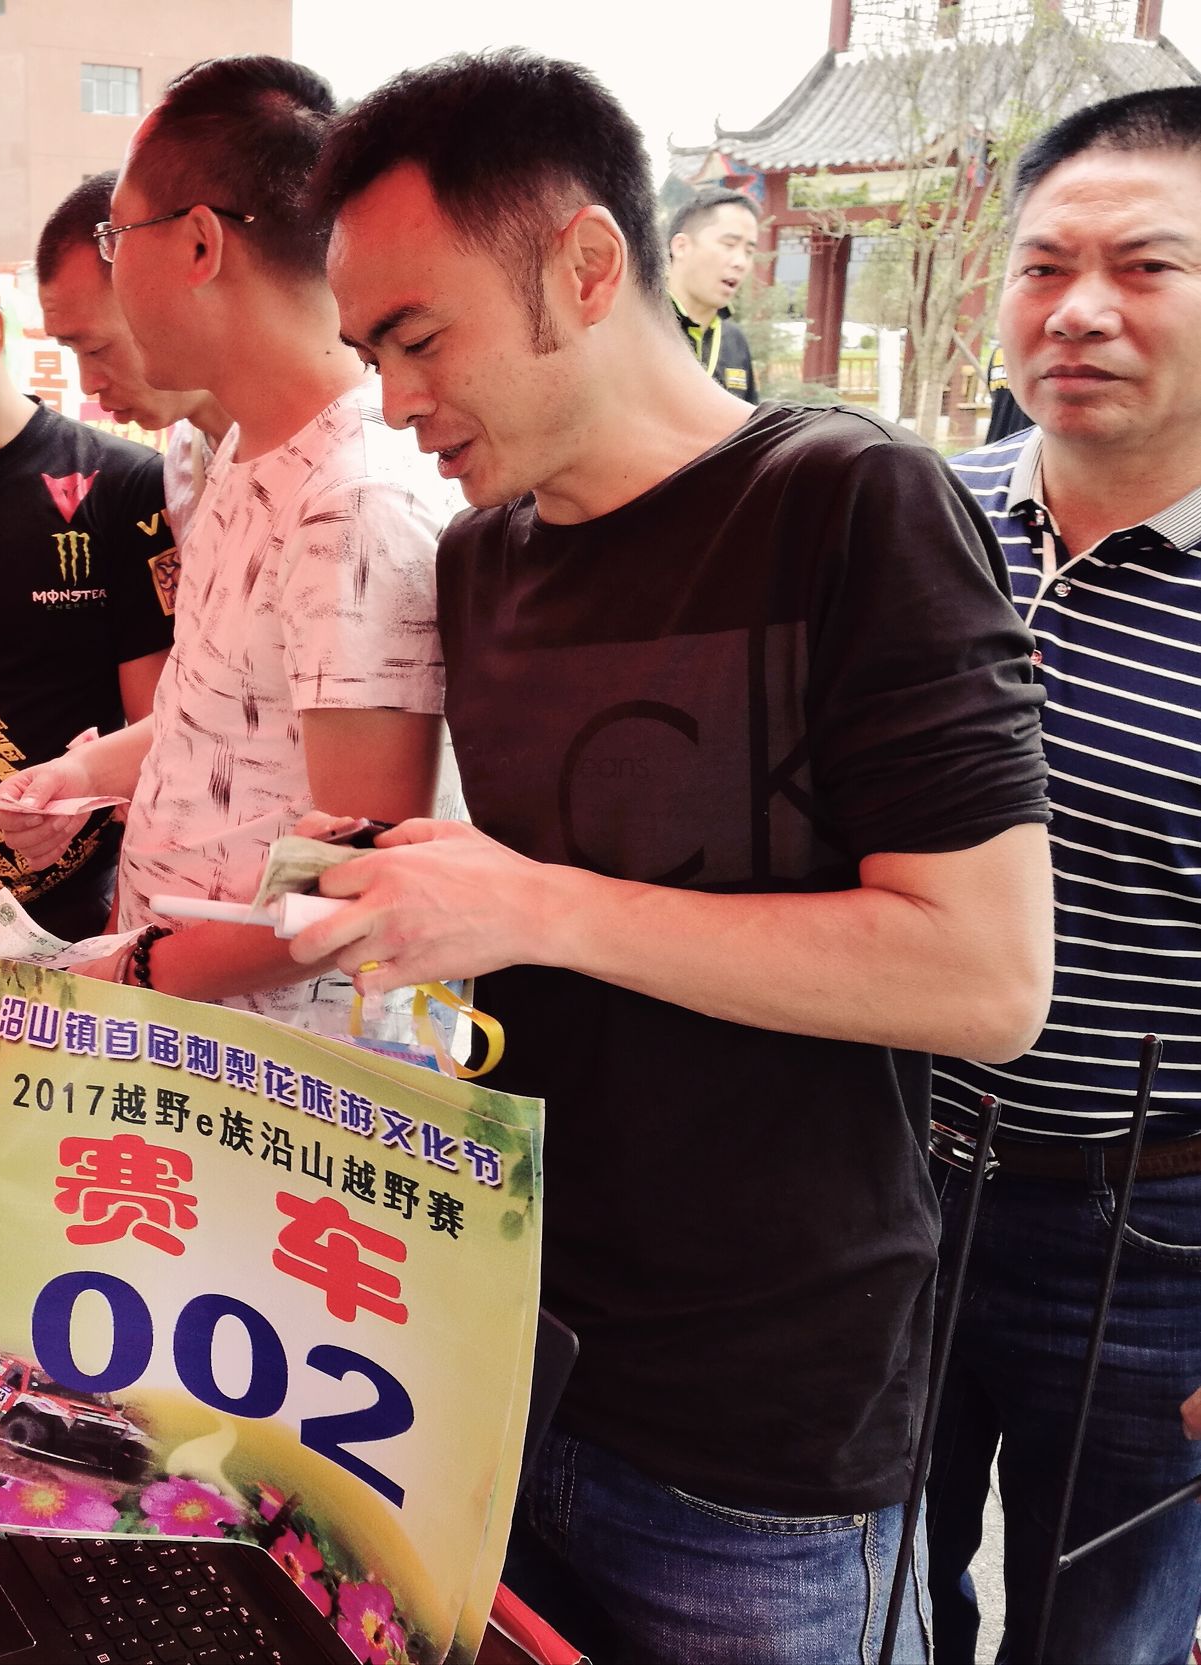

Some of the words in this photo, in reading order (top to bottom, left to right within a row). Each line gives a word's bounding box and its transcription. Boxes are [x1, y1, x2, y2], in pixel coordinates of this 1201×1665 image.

[32, 588, 107, 605] MONSTER
[12, 1073, 465, 1240] 2017越野e族沿山越野赛
[54, 1134, 409, 1325] 赛车
[31, 1270, 415, 1510] 002
